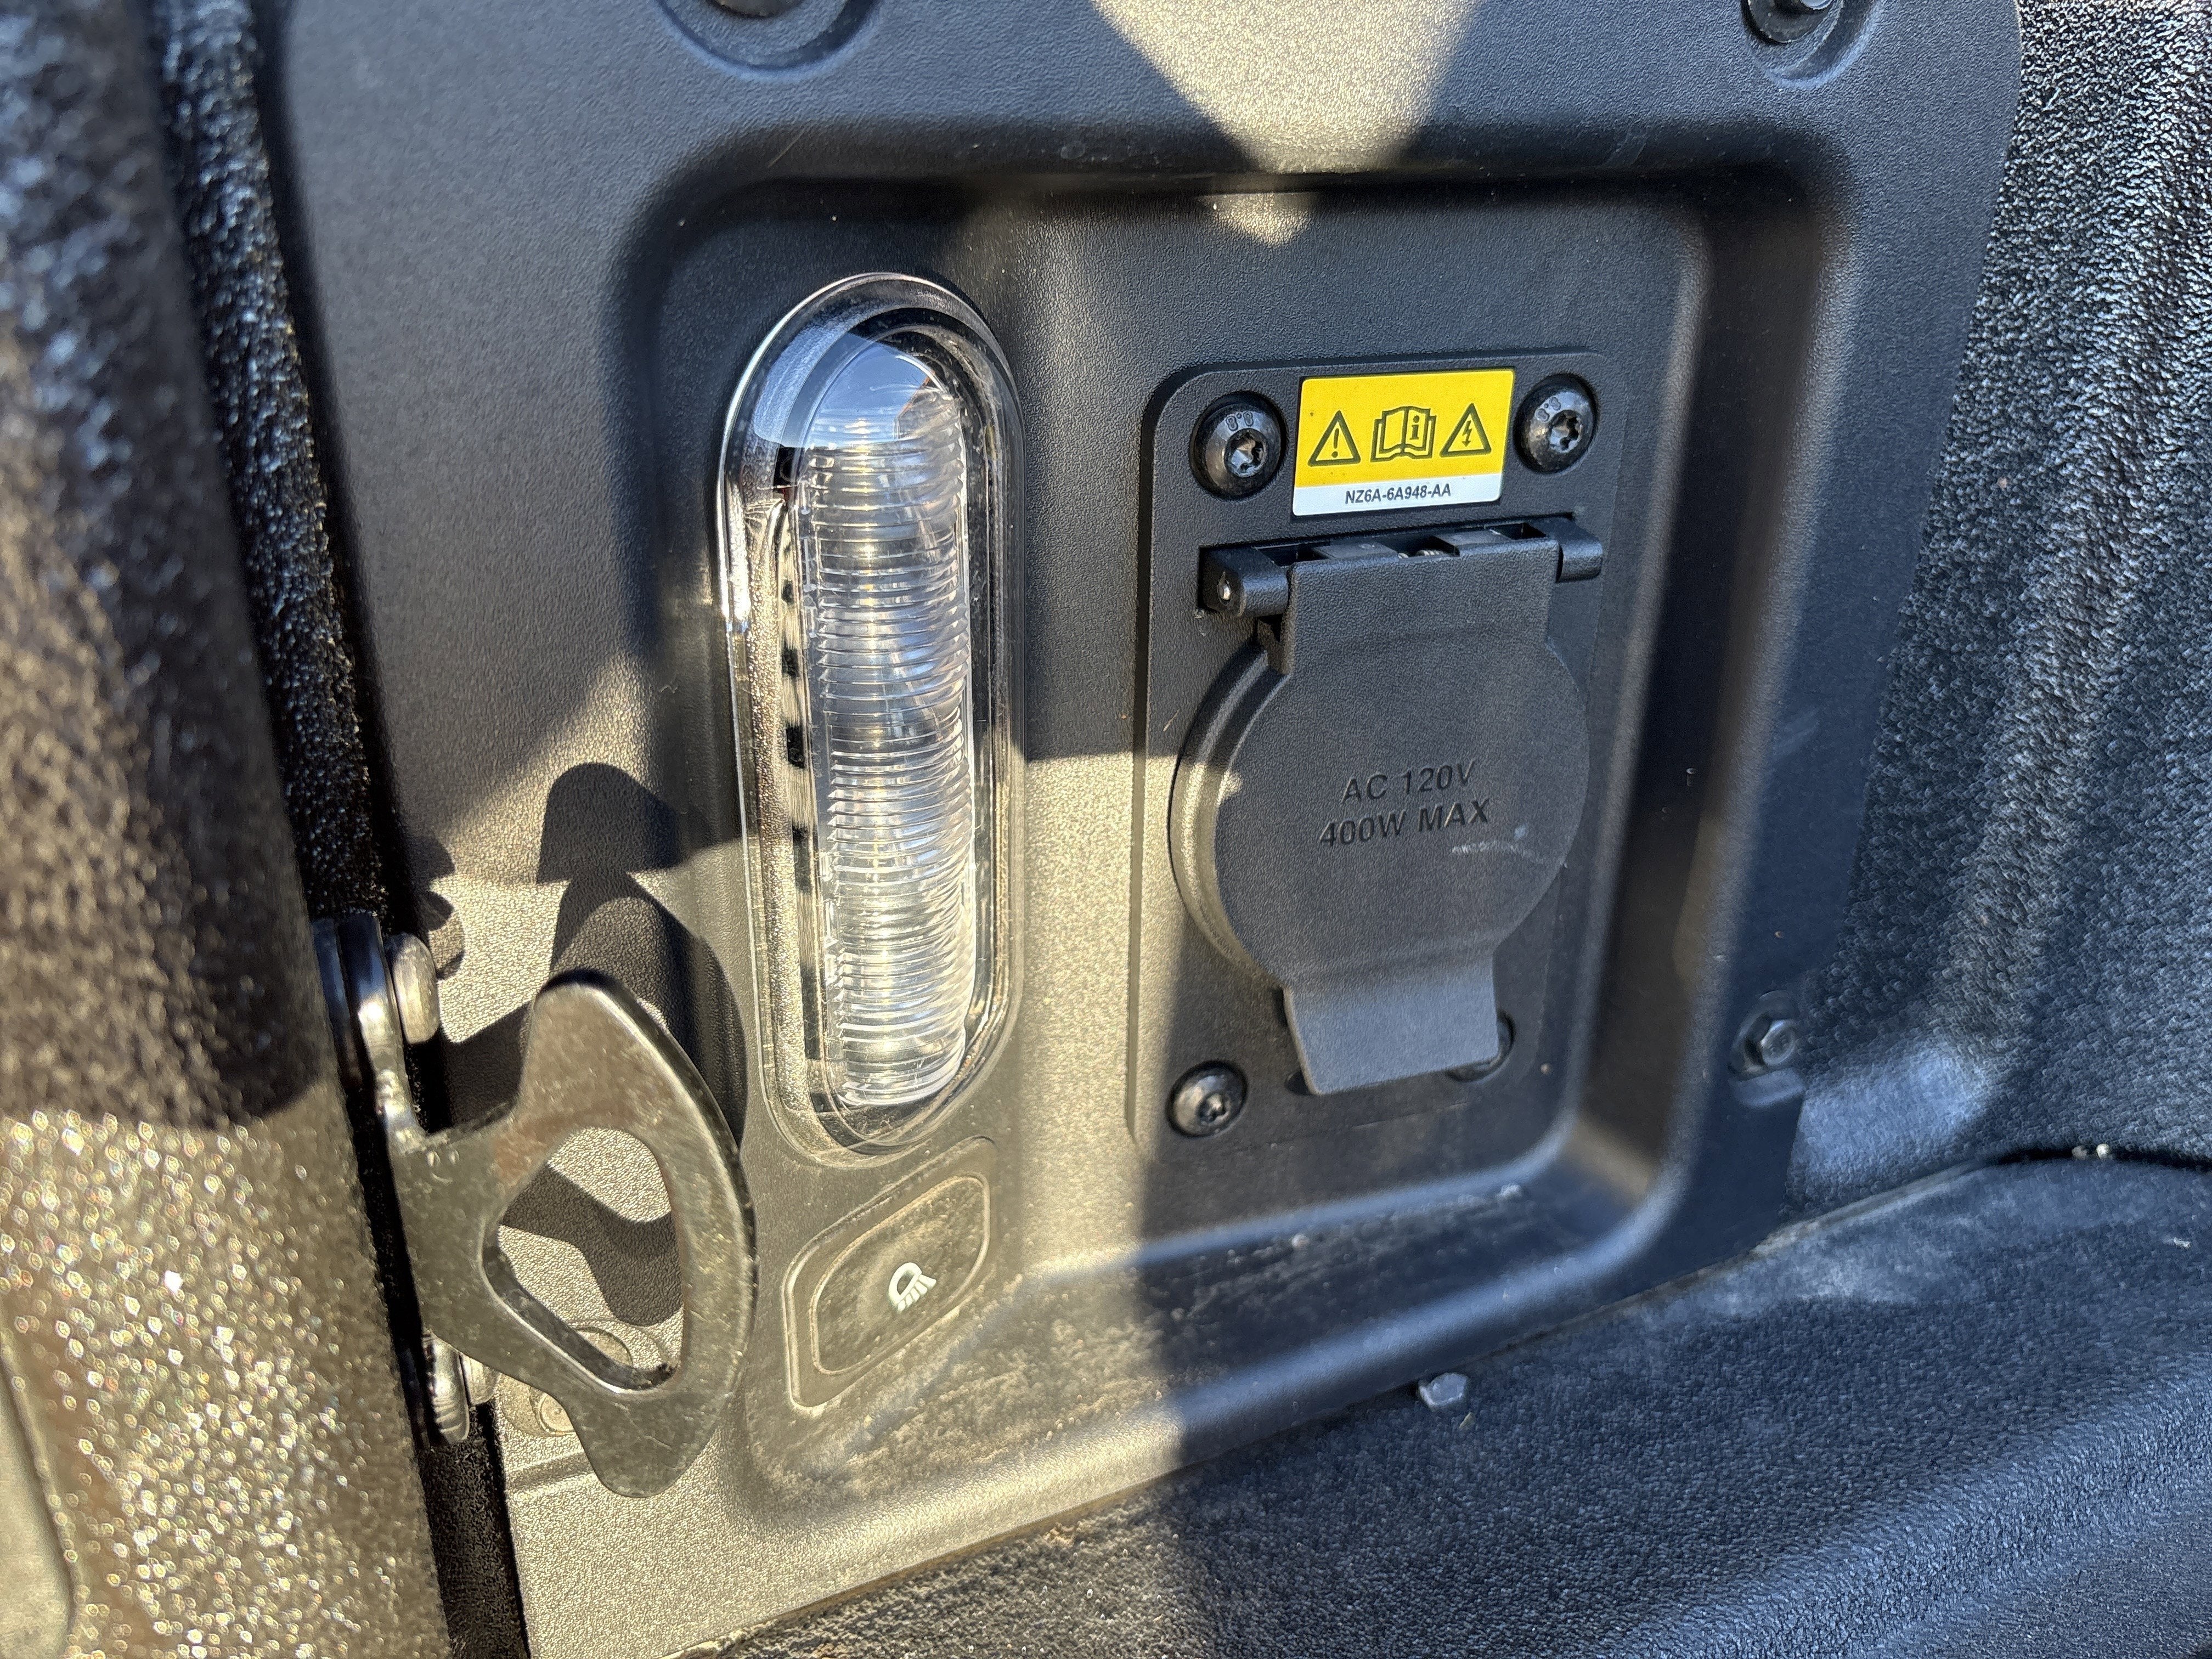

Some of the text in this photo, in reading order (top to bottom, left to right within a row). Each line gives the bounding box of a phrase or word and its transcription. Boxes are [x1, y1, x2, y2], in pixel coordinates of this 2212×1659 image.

[1345, 483, 1451, 504] NZ6A-6A948-AA
[1341, 760, 1476, 805] AC 120V
[1318, 797, 1490, 847] 400W MAX
